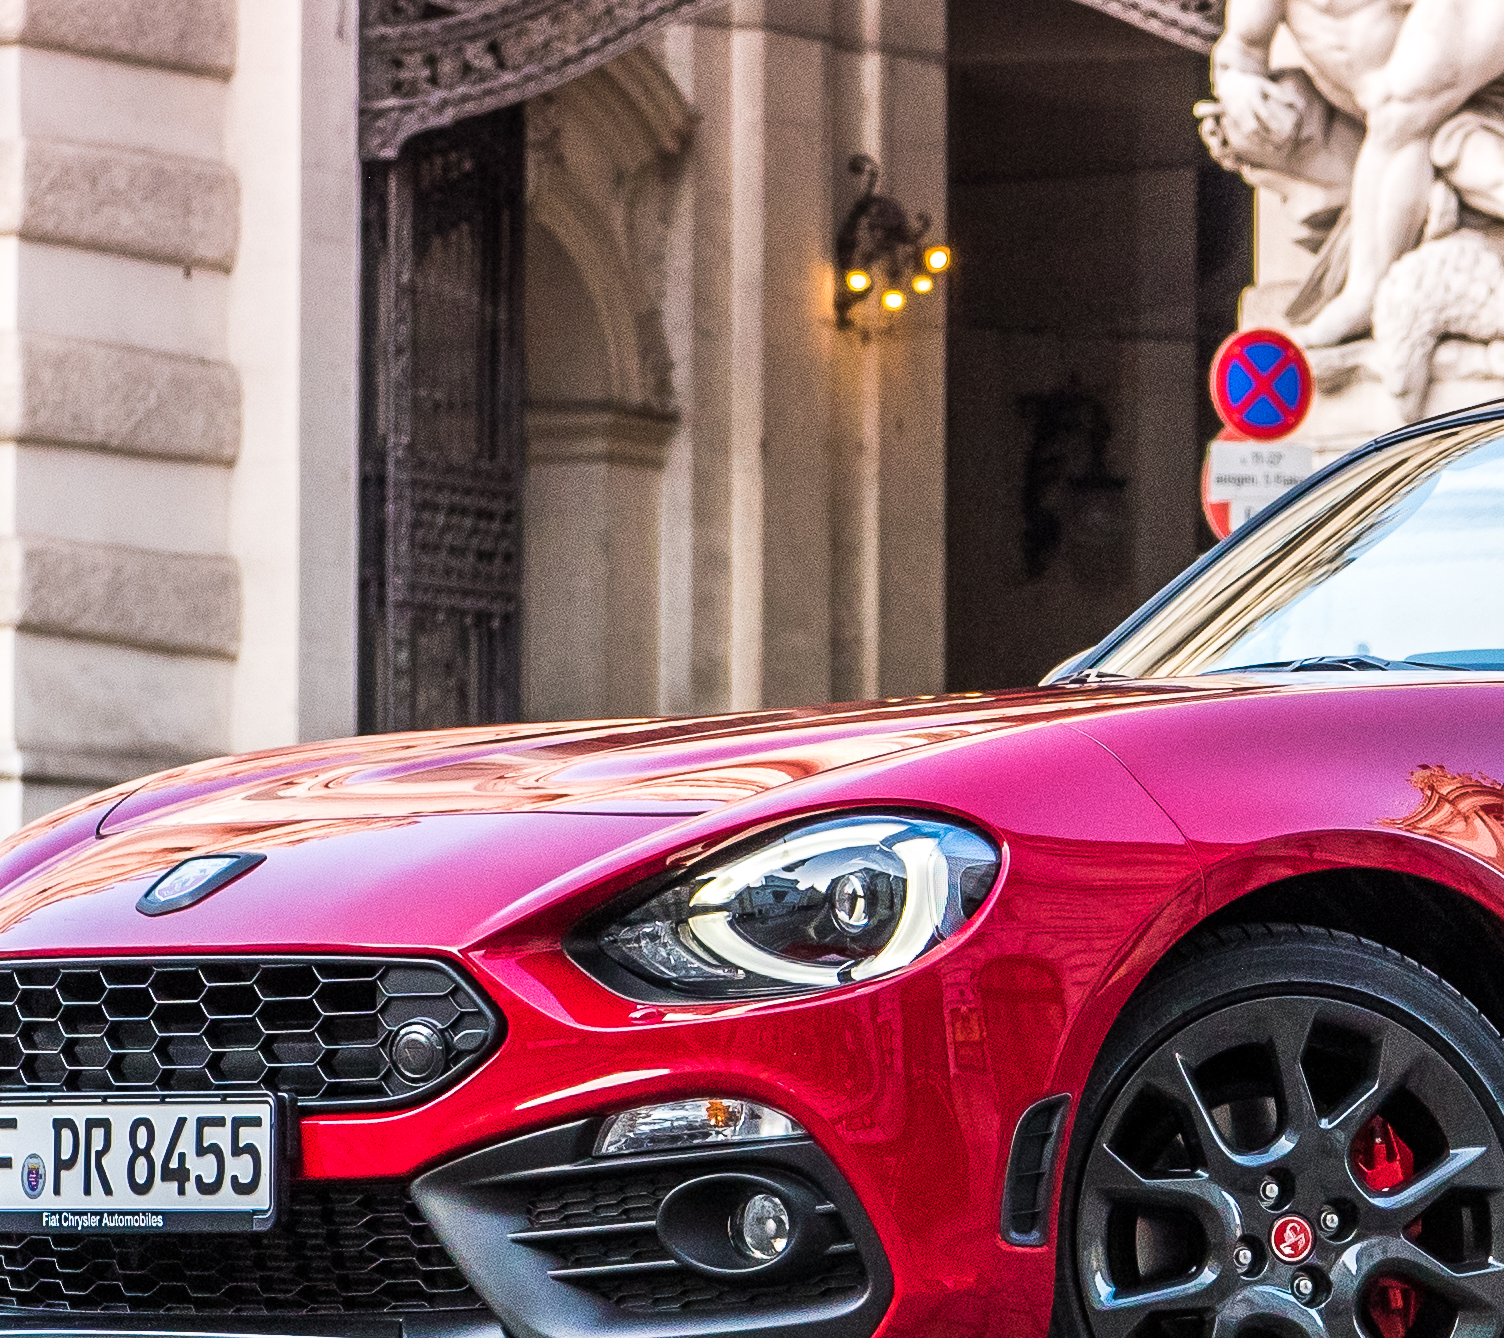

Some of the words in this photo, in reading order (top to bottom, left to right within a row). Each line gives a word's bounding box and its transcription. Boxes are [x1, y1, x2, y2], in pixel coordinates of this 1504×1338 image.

[52, 1116, 114, 1196] PR
[127, 1115, 262, 1197] 8455
[42, 1212, 60, 1227] Fiat
[61, 1212, 100, 1230] Chrysler
[102, 1212, 164, 1227] Automobiles
